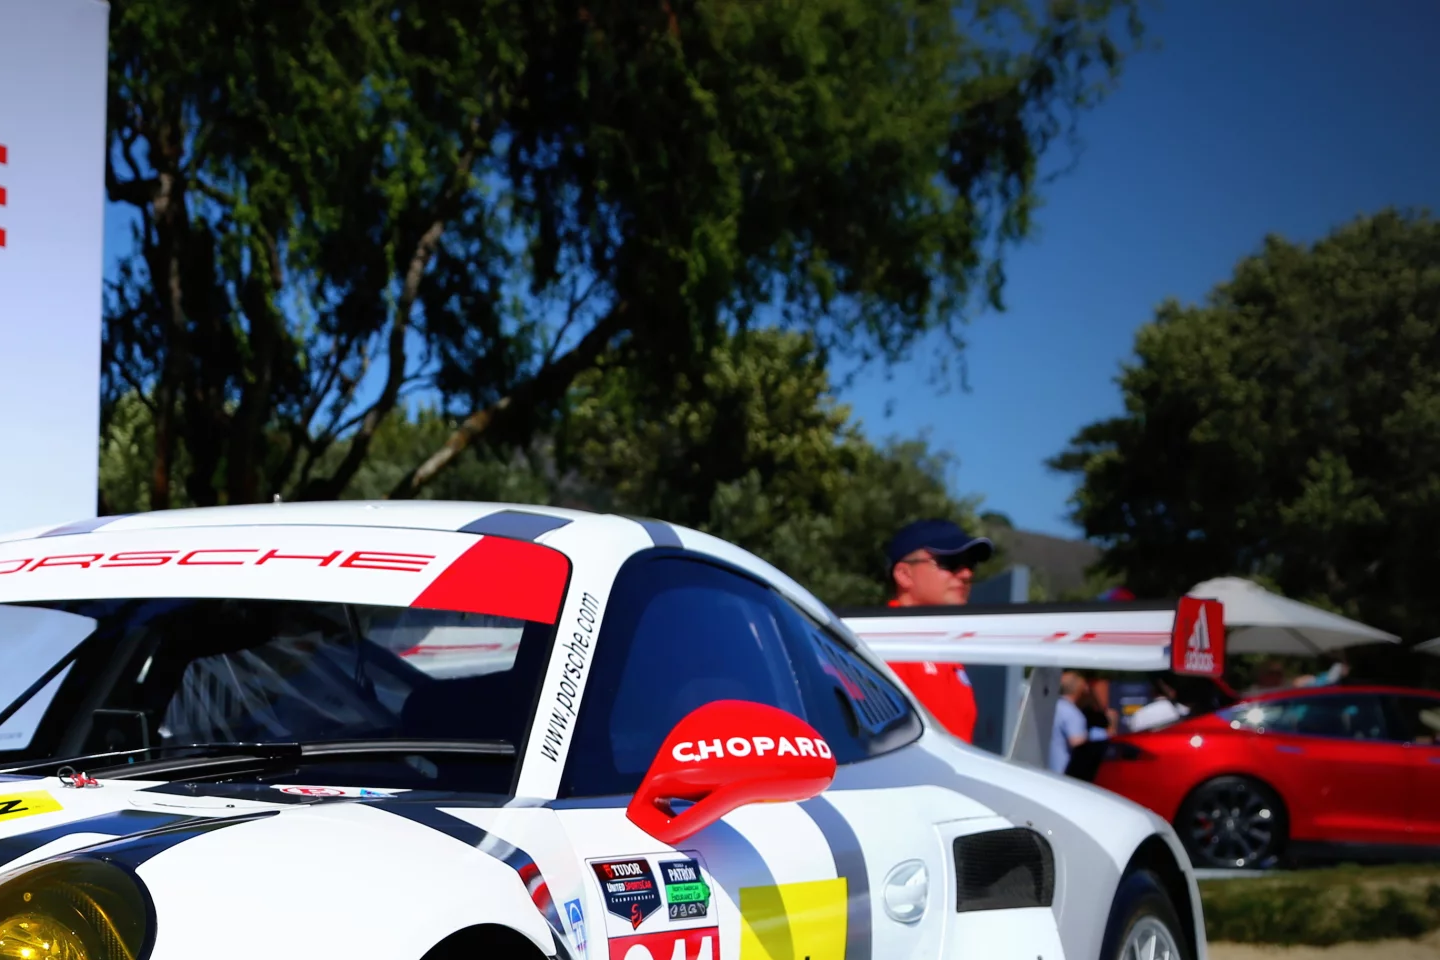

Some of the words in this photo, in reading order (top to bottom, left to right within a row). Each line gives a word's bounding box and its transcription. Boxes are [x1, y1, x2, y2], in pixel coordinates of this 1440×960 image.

[541, 592, 600, 763] www.porsche.com
[672, 736, 832, 762] CHOPARD
[611, 863, 642, 876] TUDOR
[668, 865, 697, 882] PATRÓN
